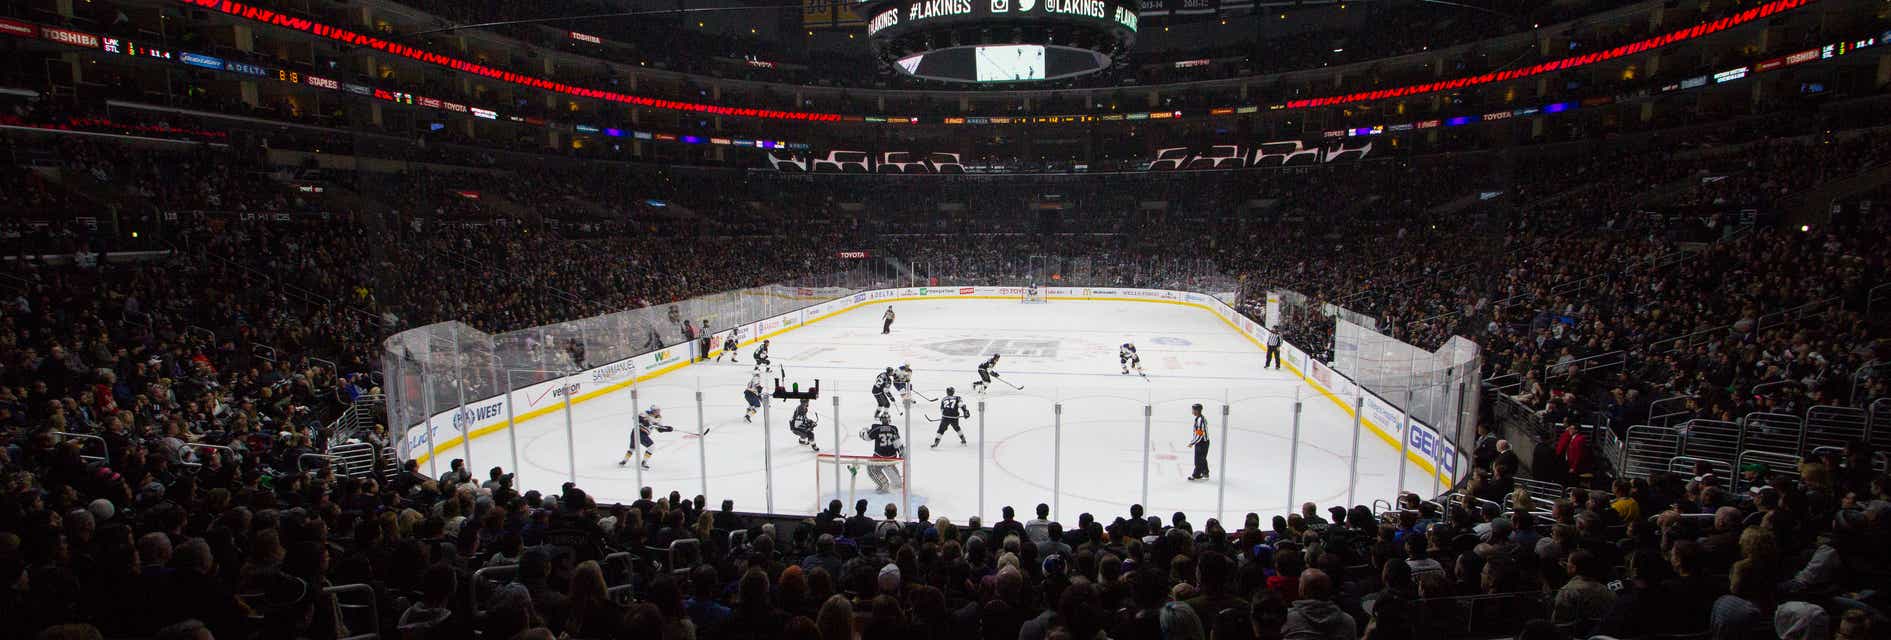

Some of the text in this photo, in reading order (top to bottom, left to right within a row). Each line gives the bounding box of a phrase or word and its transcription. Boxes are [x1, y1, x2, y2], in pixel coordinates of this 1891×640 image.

[909, 0, 971, 21] #LAKINGS
[1044, 0, 1104, 19] @LAKINGS
[42, 28, 99, 48] TOSHIBA
[1785, 49, 1819, 64] TOSHIBA
[236, 64, 266, 76] DELTA
[308, 76, 338, 89] STAPLES
[443, 101, 468, 112] TOYOTA
[1483, 111, 1511, 121] TOYOTA
[943, 398, 955, 409] 27
[477, 402, 502, 421] WEST
[878, 432, 894, 448] 32
